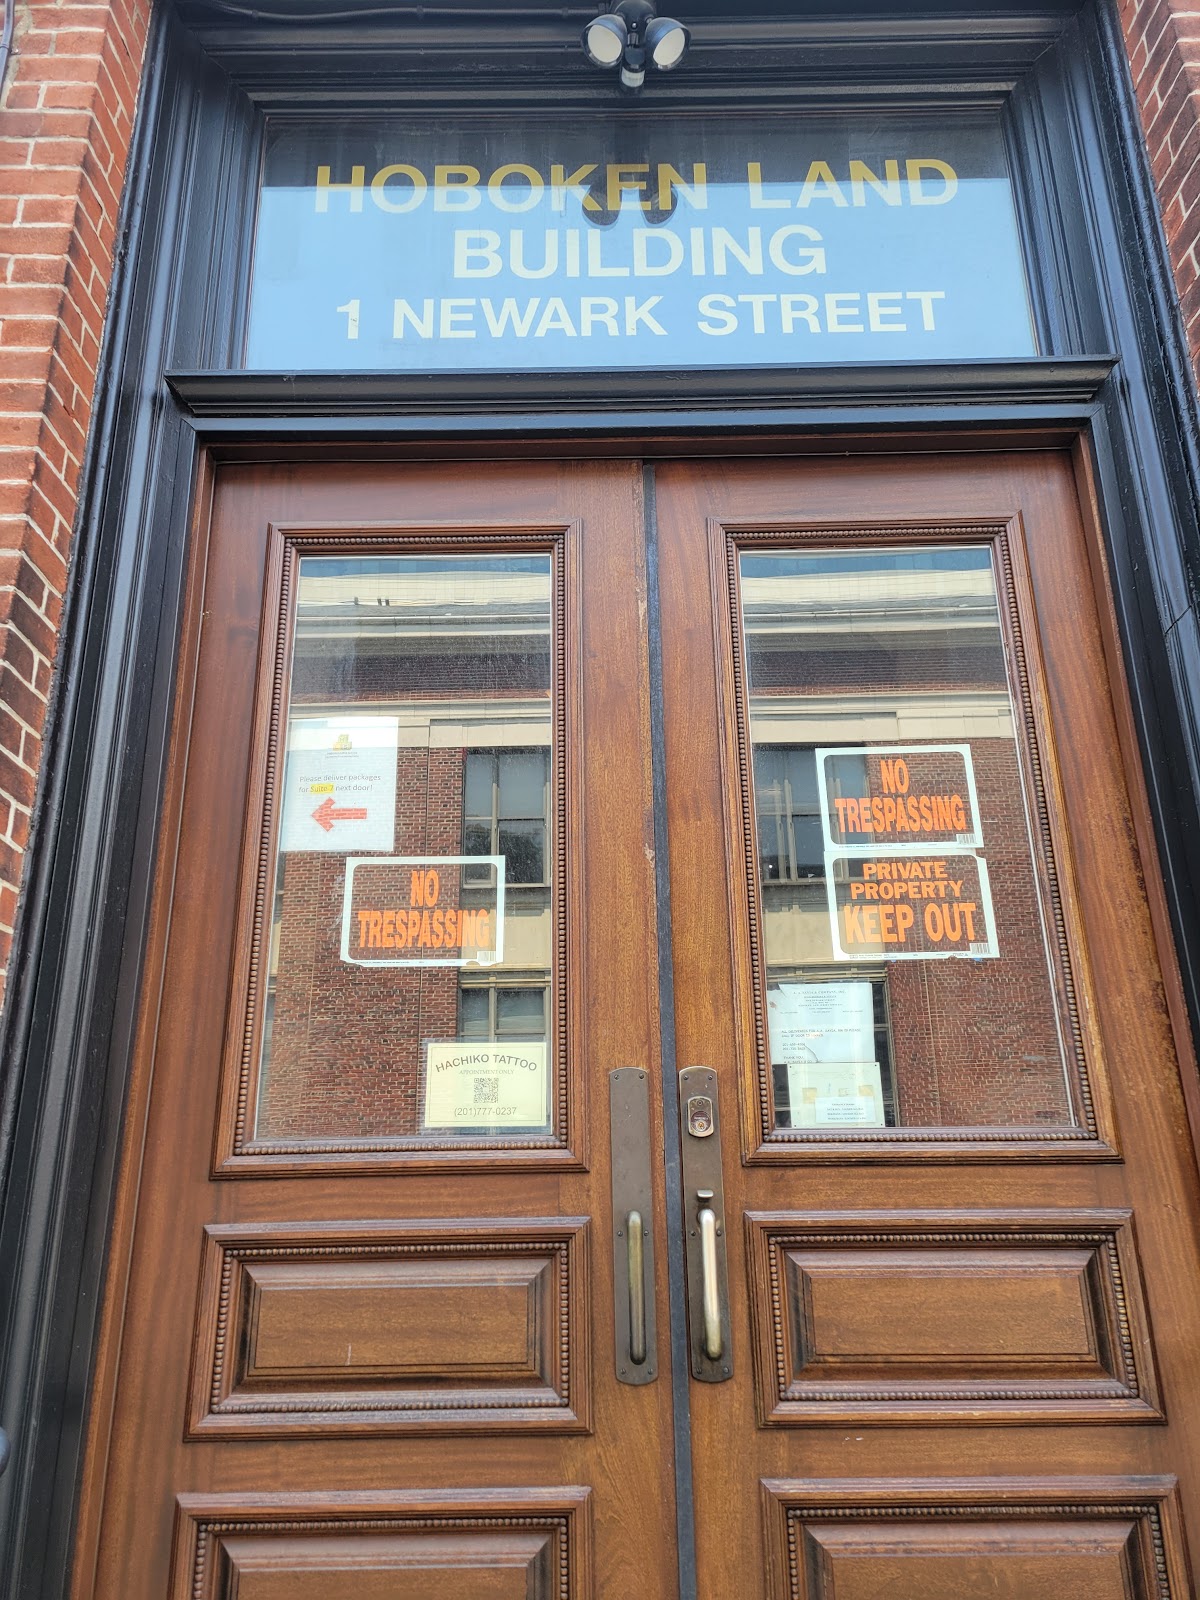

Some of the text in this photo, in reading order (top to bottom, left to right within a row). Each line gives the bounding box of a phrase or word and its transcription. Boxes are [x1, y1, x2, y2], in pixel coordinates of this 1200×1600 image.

[314, 158, 958, 214] HOBOKEN LAND
[453, 224, 828, 280] BUILDING
[335, 291, 946, 340] 1 NEWARK STREET
[298, 785, 309, 793] for
[310, 784, 328, 793] Suite
[335, 784, 351, 792] next
[352, 783, 373, 792] door!
[299, 773, 382, 783] Please deliver packages
[880, 758, 910, 794] NO
[834, 794, 967, 834] TRESPASSING
[410, 869, 440, 908] NO
[862, 861, 948, 880] PRIVATE
[850, 880, 963, 900] PROPERTY
[357, 908, 490, 949] TRESPASSING
[843, 902, 977, 944] KEEP OUT
[435, 1054, 538, 1073] HACHIKO TATTOO
[454, 1107, 517, 1118] (201)777-0237
